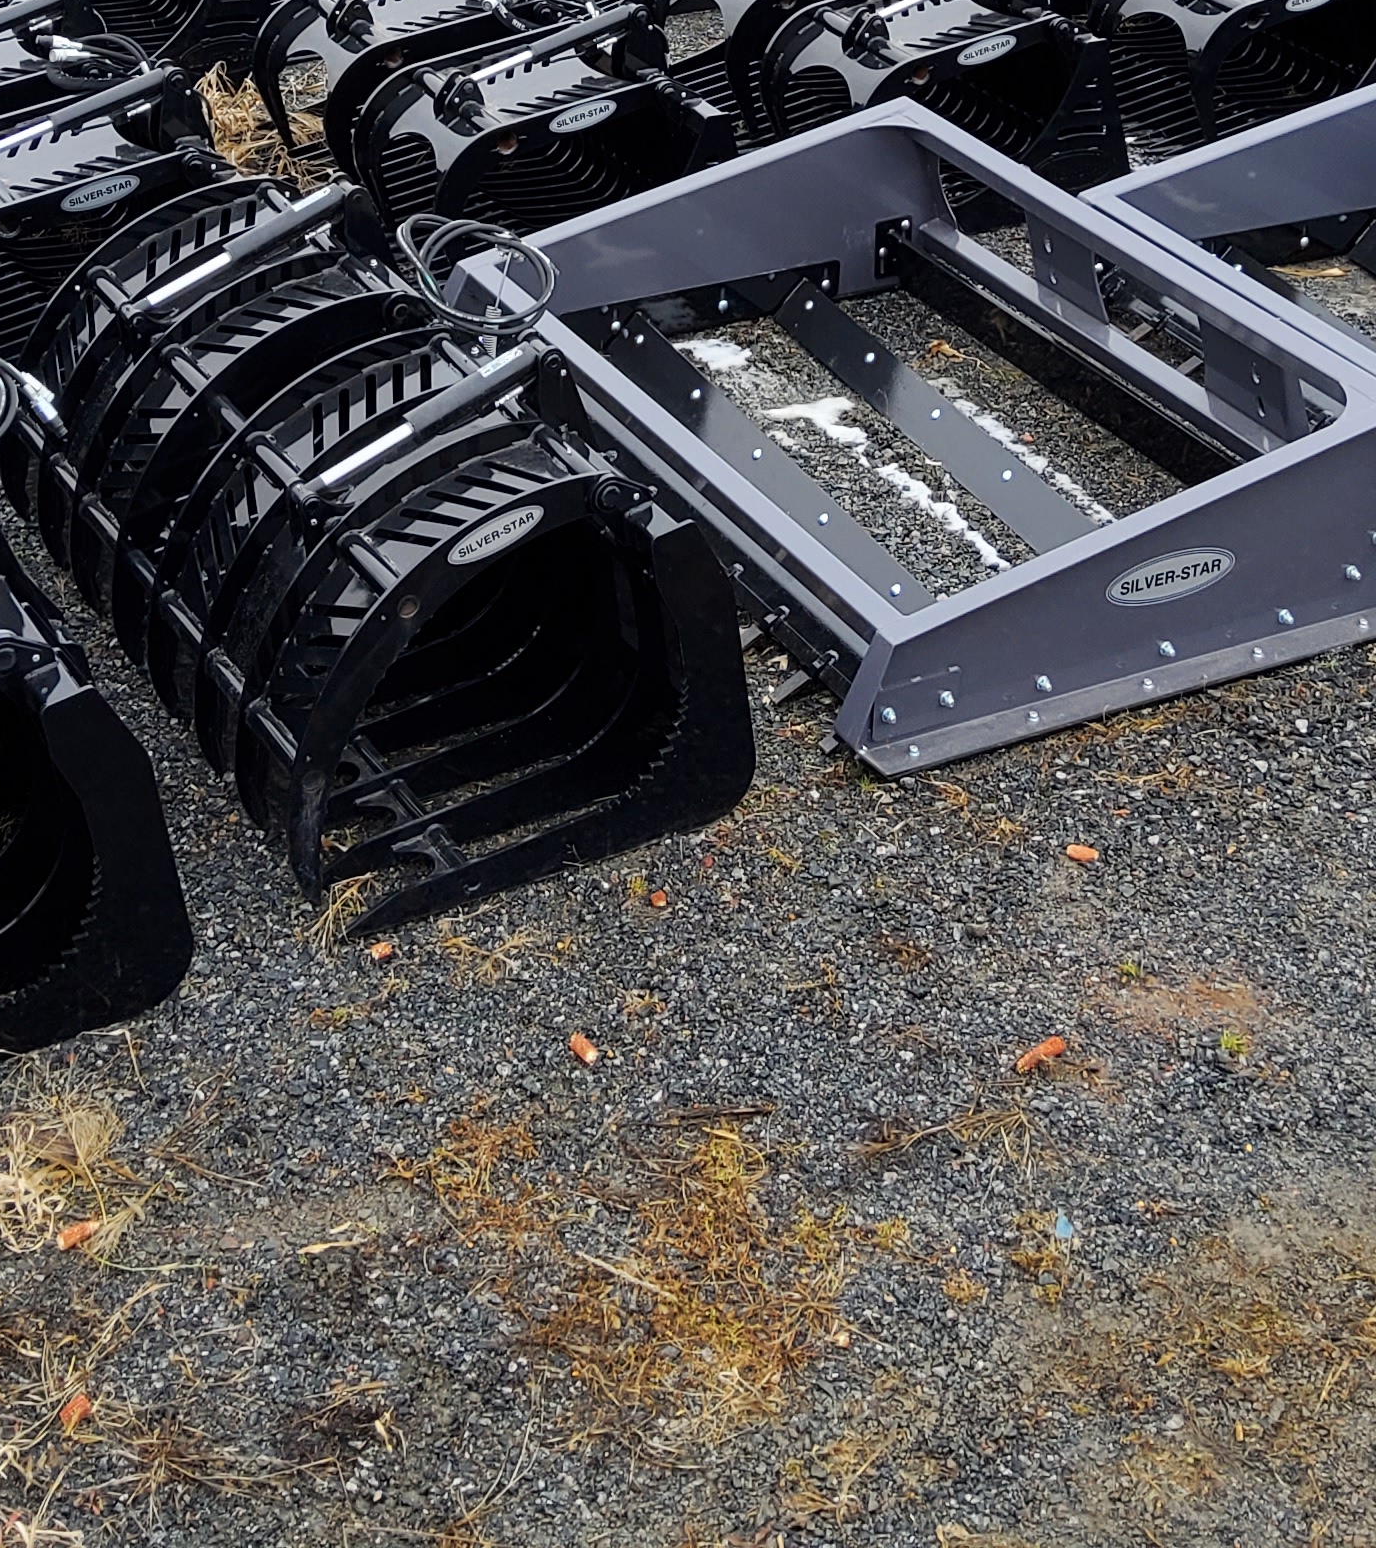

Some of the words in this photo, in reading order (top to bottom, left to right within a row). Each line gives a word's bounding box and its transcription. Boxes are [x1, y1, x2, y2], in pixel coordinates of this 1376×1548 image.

[963, 39, 1011, 61] SILVER-STAR
[556, 104, 610, 129] SILVER-STAR
[68, 179, 133, 208] SILVER-STAR
[457, 511, 536, 559] SILVER-STAR
[1119, 558, 1222, 596] SILVER-STAR
